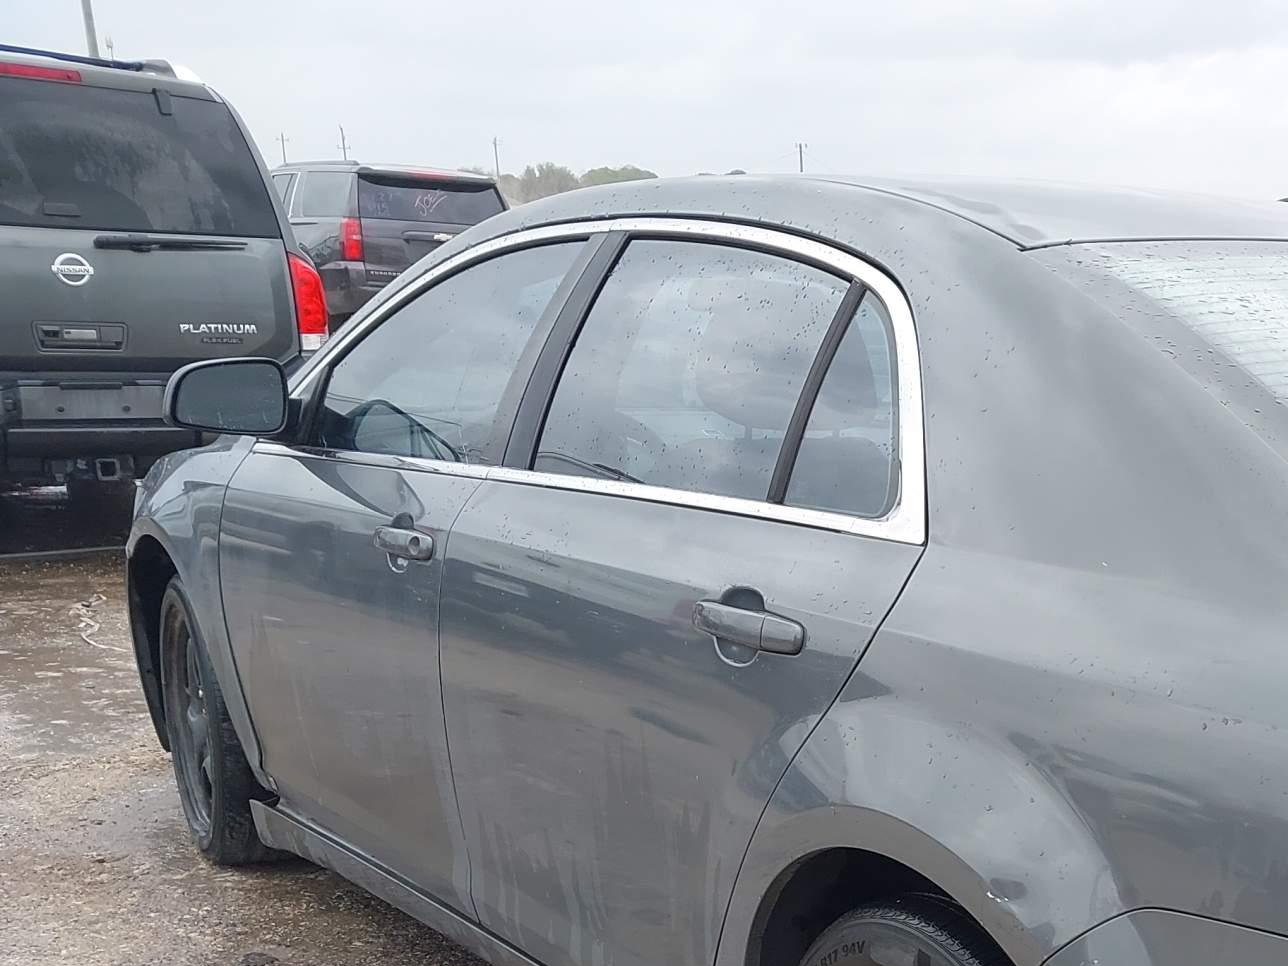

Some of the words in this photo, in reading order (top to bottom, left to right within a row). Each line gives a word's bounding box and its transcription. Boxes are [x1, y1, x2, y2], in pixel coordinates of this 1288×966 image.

[56, 266, 91, 274] NISSAN
[179, 323, 258, 335] PLATINUM
[842, 940, 866, 956] 94V
